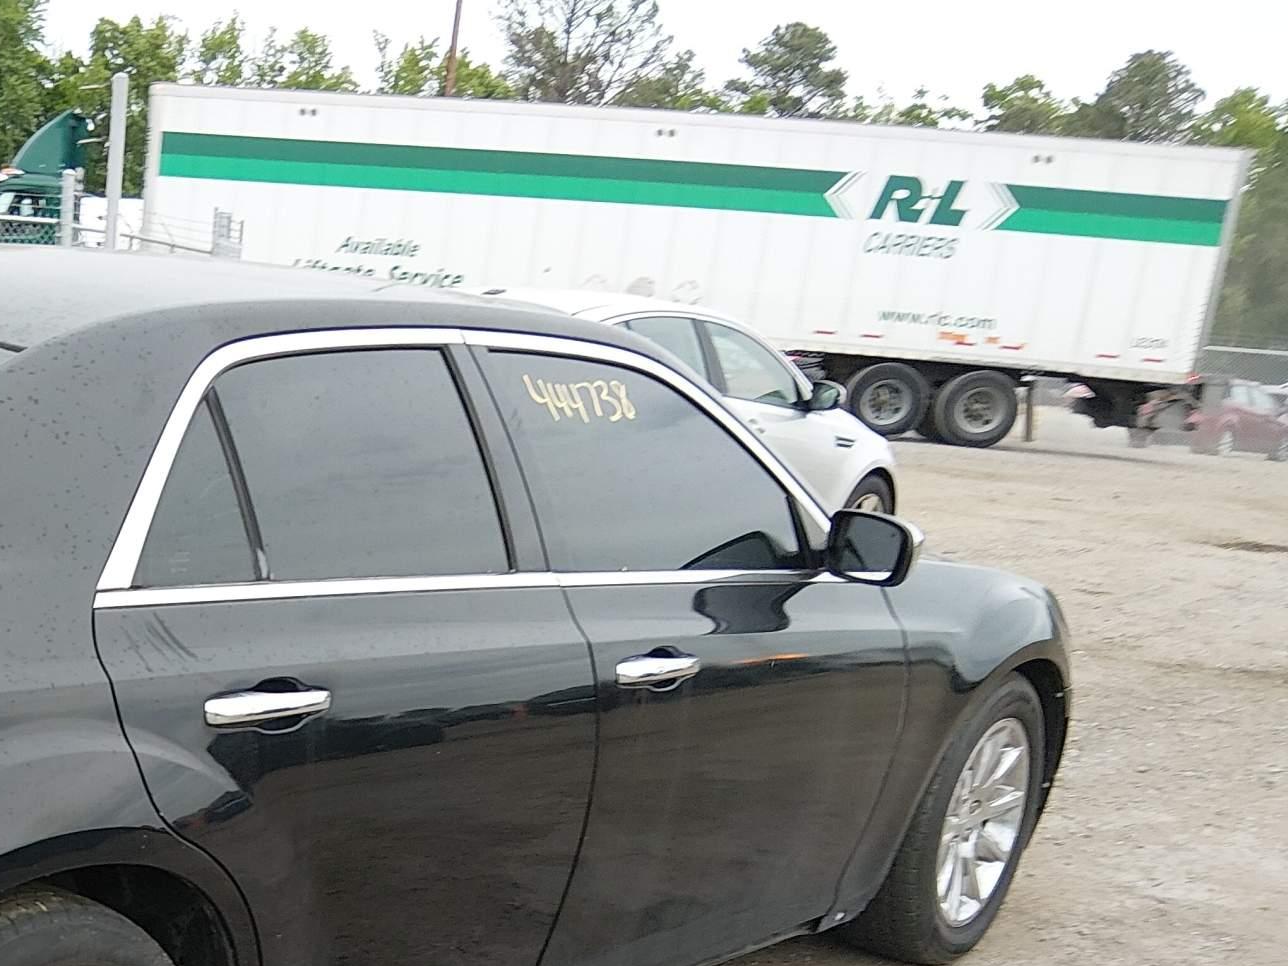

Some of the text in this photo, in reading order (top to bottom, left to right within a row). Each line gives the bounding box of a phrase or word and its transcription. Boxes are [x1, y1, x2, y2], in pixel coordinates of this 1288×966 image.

[334, 236, 420, 257] Available
[863, 231, 960, 259] CARRIERS
[389, 264, 464, 288] Service
[522, 374, 636, 423] 444738
